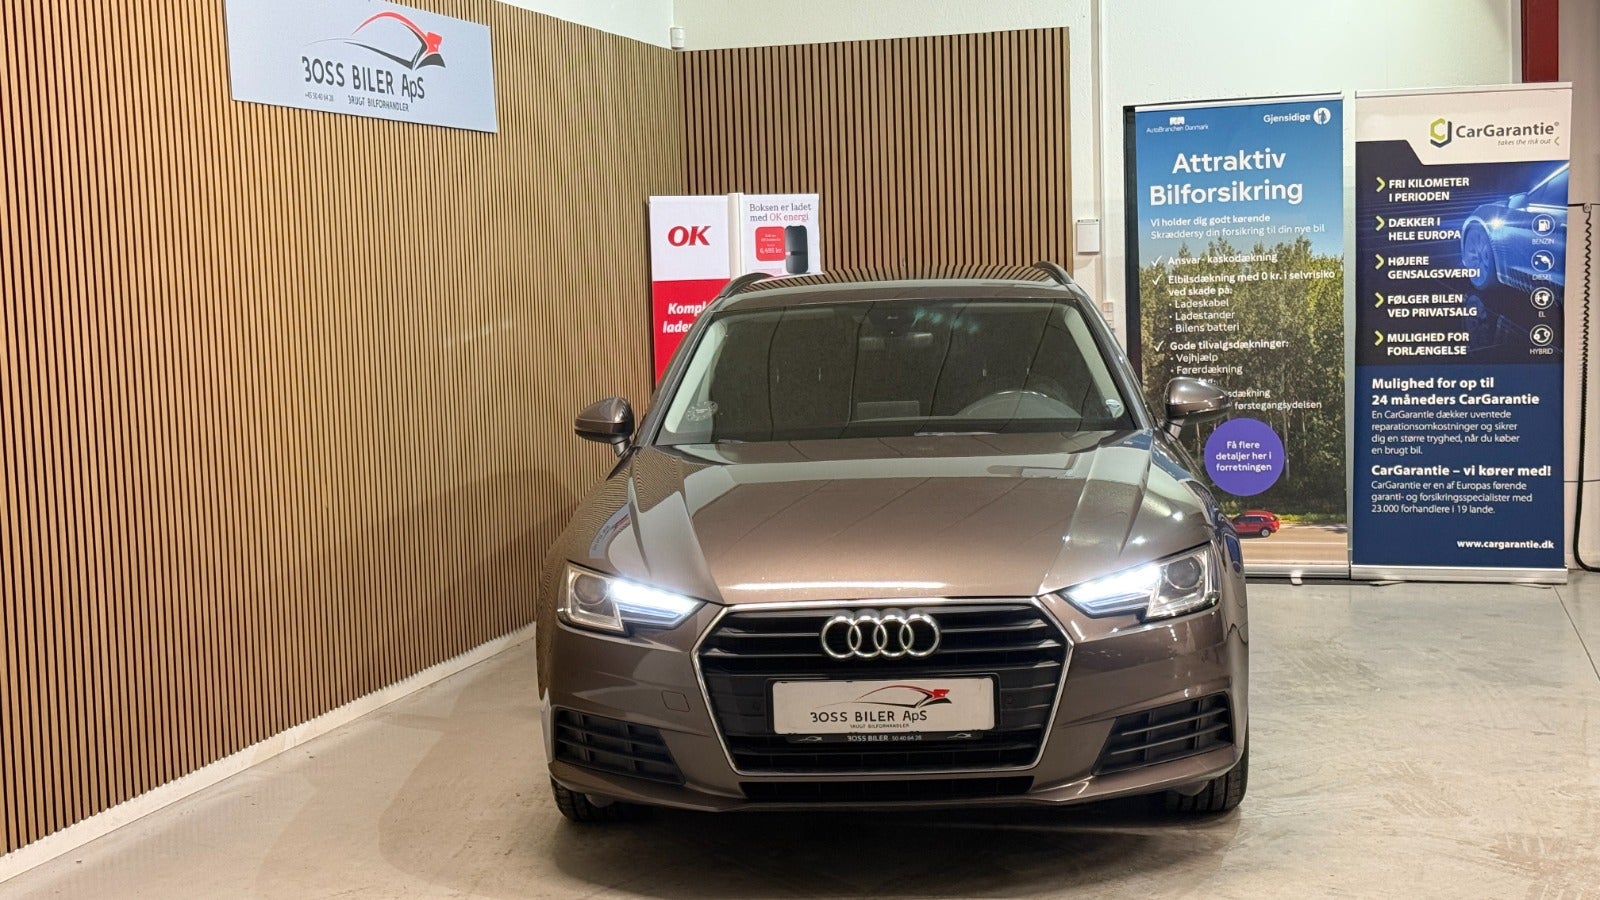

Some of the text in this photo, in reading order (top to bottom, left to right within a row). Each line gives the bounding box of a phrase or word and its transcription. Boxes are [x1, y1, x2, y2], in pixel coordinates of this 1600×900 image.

[352, 65, 394, 95] BILER
[402, 74, 425, 102] ApS
[368, 98, 409, 112] BILFORHANDLER
[1264, 114, 1310, 124] Gjensidige
[1172, 147, 1286, 174] Attraktiv
[1389, 178, 1469, 189] FRI KILOMETER
[1150, 179, 1302, 206] Bilforsikring
[1389, 192, 1450, 202] I PERIODEN
[750, 203, 778, 212] Boksen
[791, 203, 811, 211] ladet
[750, 213, 809, 222] med OK energi
[1151, 214, 1271, 227] Vi holder dig godt kørende
[1389, 217, 1440, 227] DÆKKER I
[668, 226, 711, 246] OK
[1151, 224, 1325, 240] Skræddersy din forsikring til din nye bil
[1389, 230, 1461, 241] HELE EUROPA
[1208, 254, 1277, 263] kaskodækning
[1388, 256, 1429, 266] HØJERE
[1168, 271, 1335, 284] Elbilsdækning med 0 kr. i selvrisiko
[1388, 269, 1480, 280] GENSALGSVÆRDI
[1169, 286, 1233, 296] ved skade på:
[1175, 299, 1229, 309] Ladeskabel
[1388, 294, 1463, 305] FØLGER BILEN
[1175, 312, 1235, 321] Ladestander
[1388, 307, 1477, 317] VED PRIVATSALG
[1176, 323, 1239, 333] Bilens batteri
[1388, 333, 1469, 343] MULIGHED FOR
[1170, 340, 1289, 351] Gode tilvalgsdækninger:
[1388, 346, 1467, 356] FORLÆNGELSE
[1176, 353, 1218, 363] Vejhjælp
[1176, 365, 1243, 375] Førerdækning
[1372, 377, 1494, 391] Mulighed for op til
[1372, 393, 1539, 406] 24 måneders CarGarantie
[1235, 401, 1322, 410] førstegangsydelsen
[1372, 410, 1511, 419] En CarGarantie dækker uventede
[1371, 422, 1518, 432] reparationsomkostninger og sikrer
[1371, 434, 1385, 444] dig
[1400, 435, 1424, 443] større
[1427, 434, 1463, 444] tryghed,
[1465, 434, 1478, 443] når
[1481, 434, 1492, 443] du
[1494, 434, 1520, 443] køber
[1227, 440, 1260, 449] Få flere
[1371, 446, 1422, 456] en brugt bil.
[1215, 452, 1271, 461] detaljer her i
[1216, 463, 1272, 472] forretningen
[1371, 465, 1450, 476] CarGarantie
[1463, 465, 1475, 475] vi
[1479, 465, 1514, 476] kører
[1518, 466, 1551, 476] med!
[1371, 481, 1420, 490] CarGarantie
[1446, 481, 1455, 489] af
[1457, 481, 1491, 491] Europas
[1493, 481, 1527, 490] førende
[1371, 492, 1532, 503] garanti- og forsikringsspecialister med
[1371, 504, 1495, 513] 23.000 forhandlere i 19 lande.
[1457, 540, 1554, 550] www.cargarantie.dk
[855, 711, 894, 722] BILER
[903, 710, 927, 723] ApS
